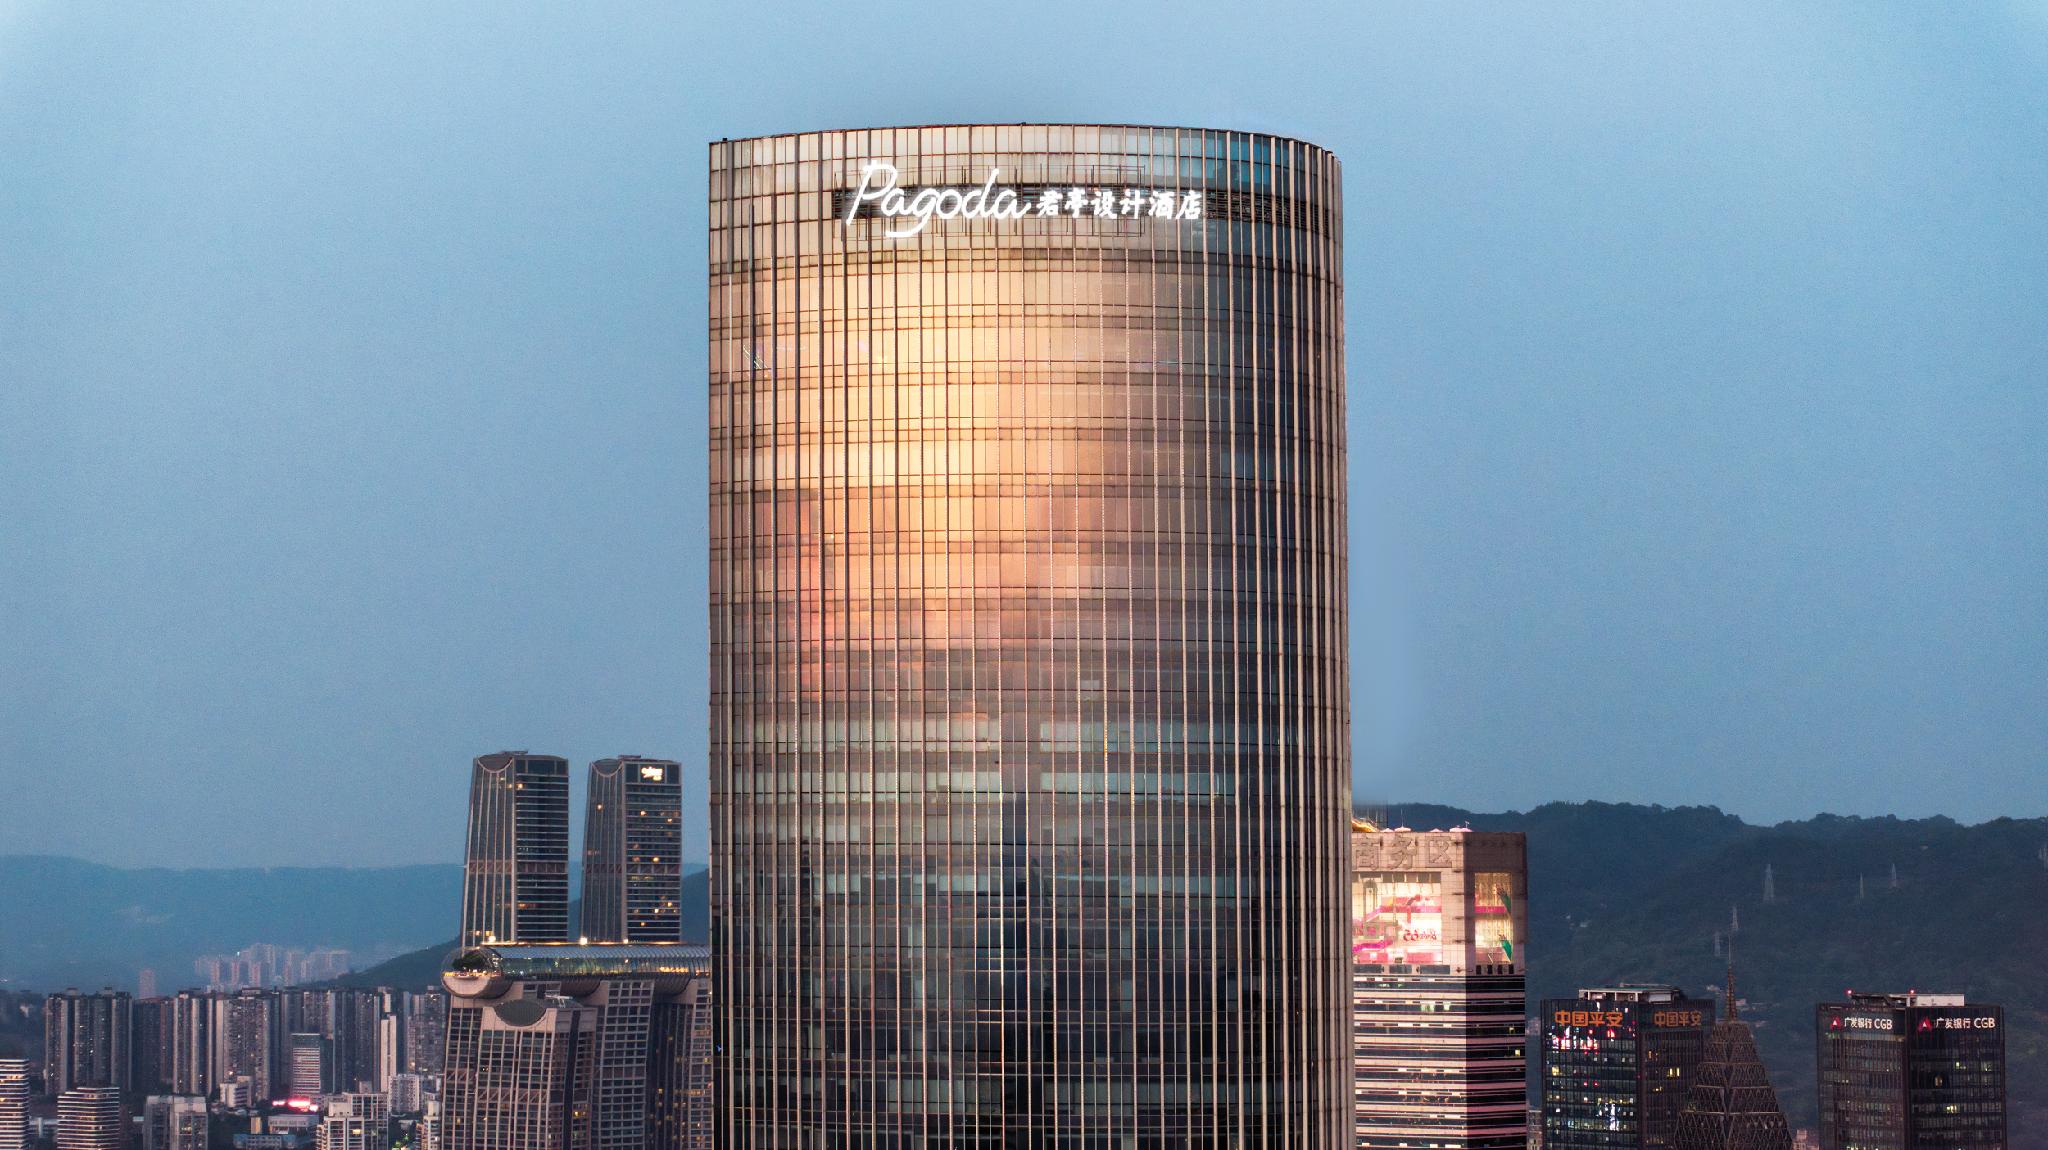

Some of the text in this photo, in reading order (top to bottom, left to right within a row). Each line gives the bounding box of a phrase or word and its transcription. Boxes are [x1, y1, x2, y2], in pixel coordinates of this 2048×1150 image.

[845, 160, 1203, 238] Pagoda 君亭设计酒店
[1351, 833, 1453, 871] 商务区
[1554, 1009, 1624, 1028] 中国平安
[1654, 1009, 1703, 1027] 中国平安
[1844, 1016, 1893, 1030] 广发银行 CGB
[1936, 1016, 1996, 1030] 广发银行 CGB
